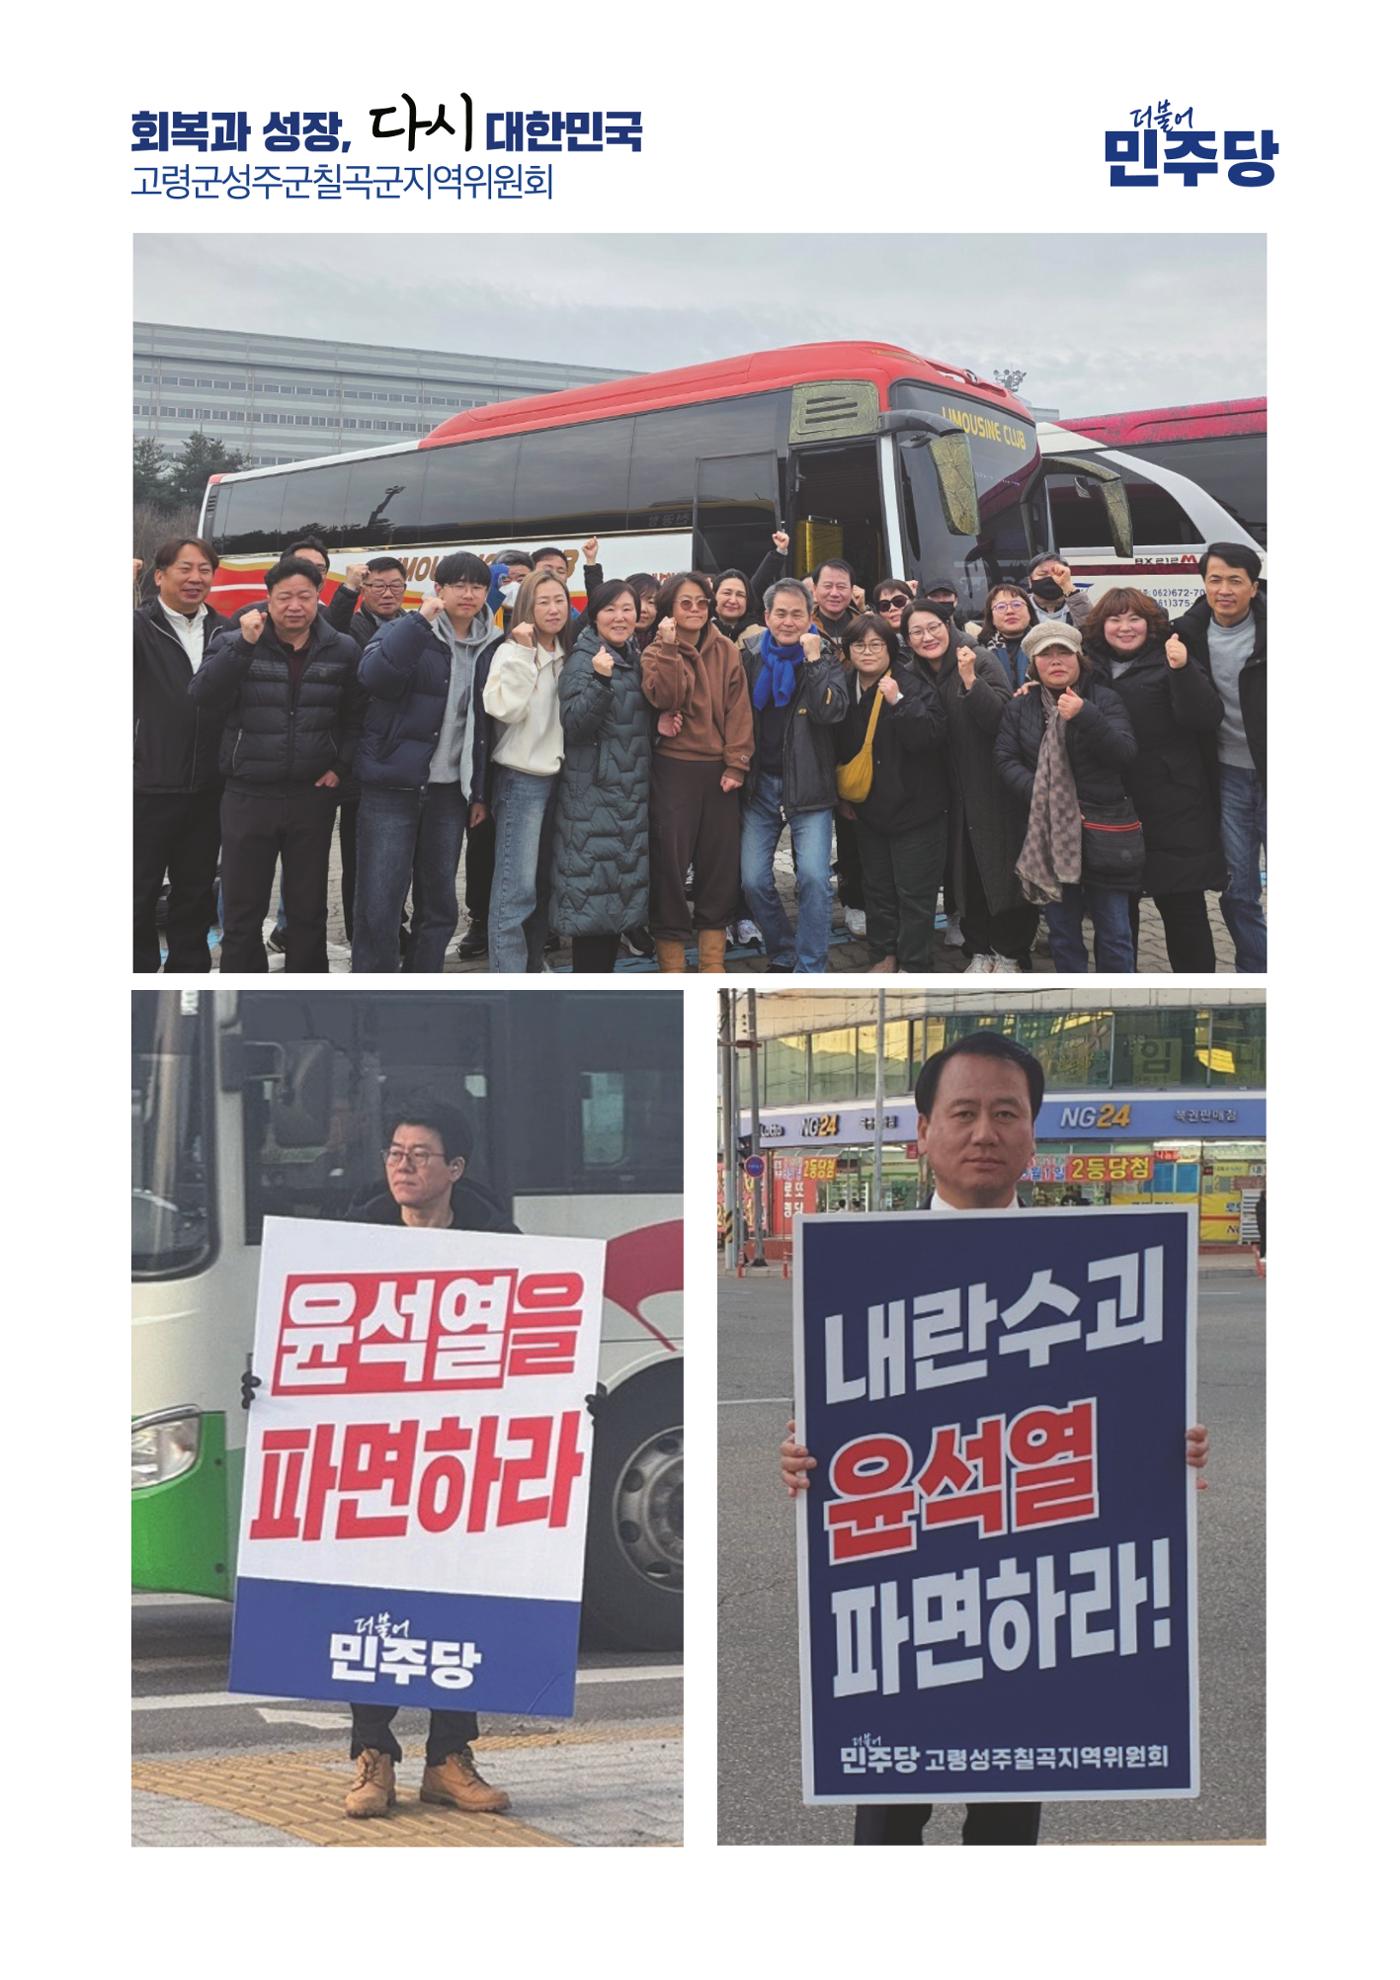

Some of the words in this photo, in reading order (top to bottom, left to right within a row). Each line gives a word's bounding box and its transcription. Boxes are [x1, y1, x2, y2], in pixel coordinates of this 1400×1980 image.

[1003, 425, 1026, 450] CLUB
[1060, 1104, 1131, 1129] NG24
[1071, 1157, 1149, 1180] 2등당첨
[277, 1271, 585, 1388] 윤석열을
[824, 1245, 1164, 1404] 내란수괴
[249, 1410, 585, 1542] 파면하라
[824, 1396, 1099, 1566] 윤석열
[354, 1612, 409, 1639] 더불어
[831, 1537, 1172, 1698] 파면하라!
[330, 1633, 482, 1690] 민주당
[840, 1746, 920, 1773] 민주당
[925, 1745, 1169, 1772] 고령성주칠곡지역위원회
